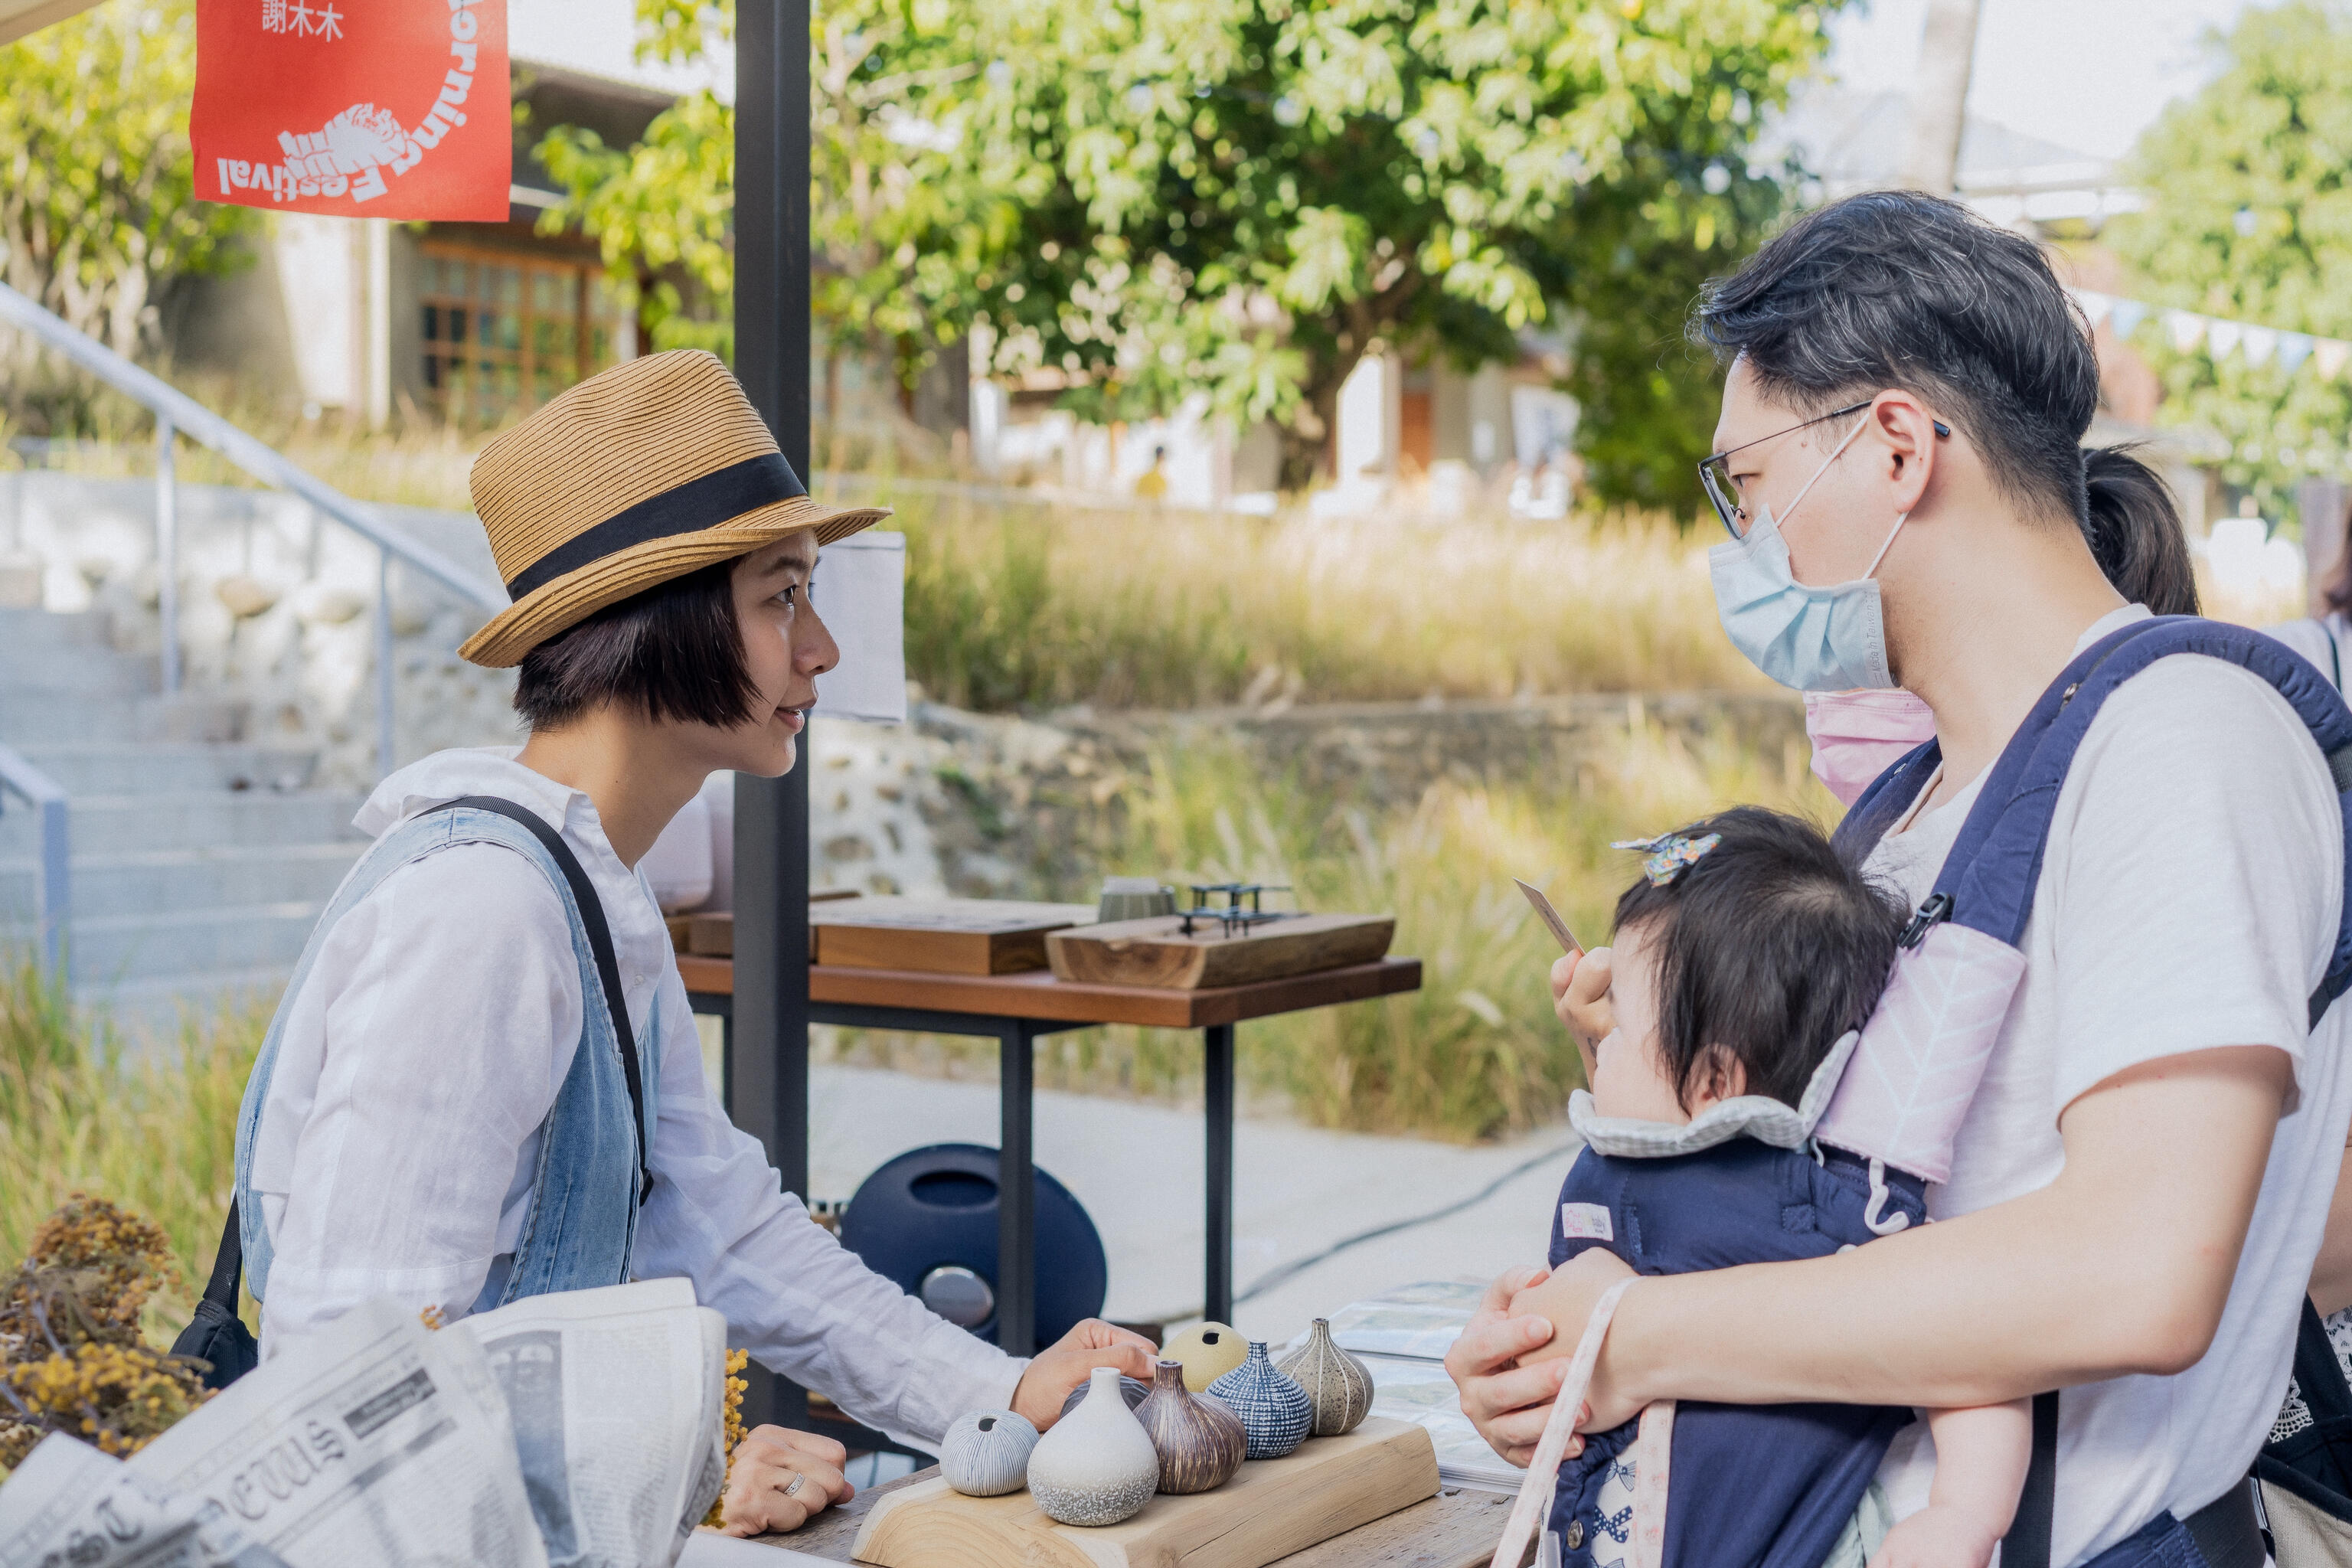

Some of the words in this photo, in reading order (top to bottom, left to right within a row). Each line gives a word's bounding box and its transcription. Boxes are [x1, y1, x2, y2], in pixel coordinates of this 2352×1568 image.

[262, 0, 344, 42] 謝木木
[390, 0, 484, 177] orning
[217, 157, 389, 204] Festival
[204, 1419, 346, 1521] ews
